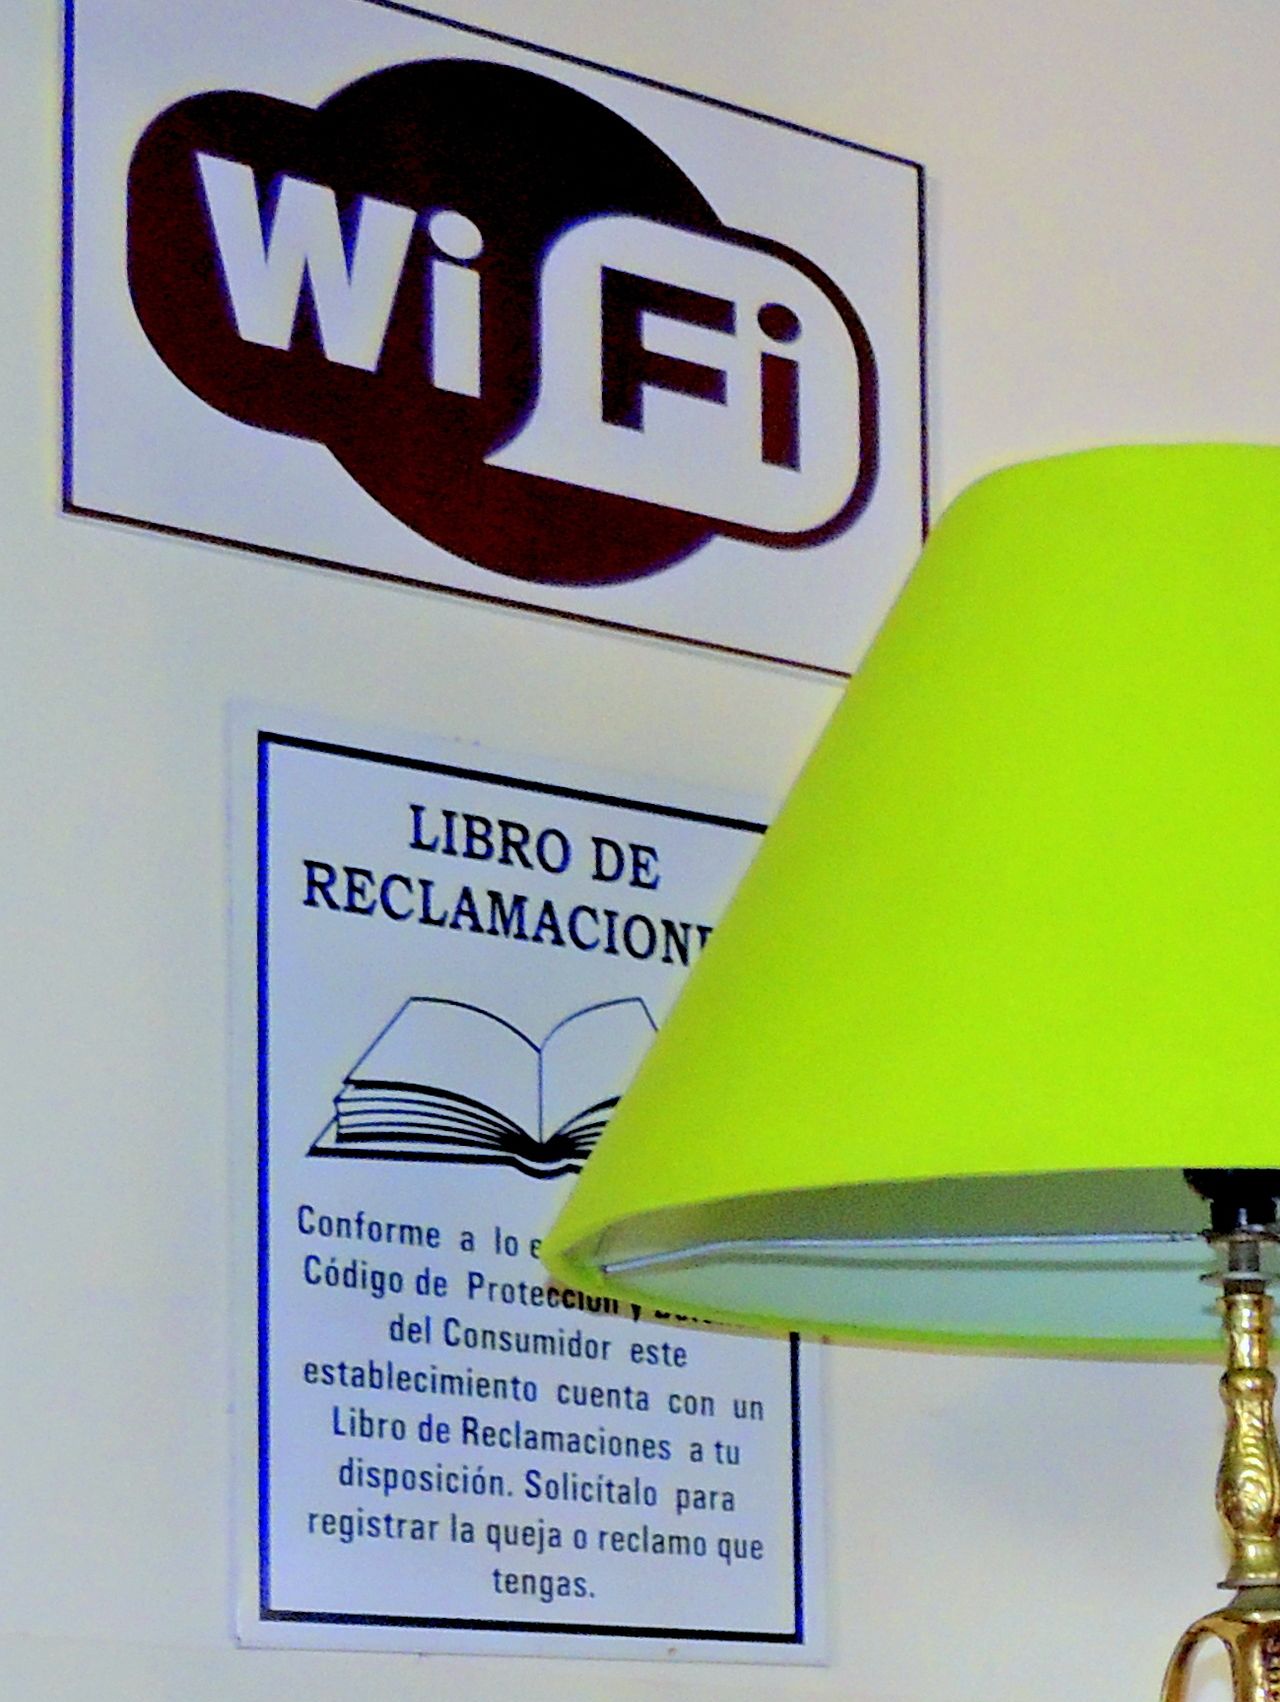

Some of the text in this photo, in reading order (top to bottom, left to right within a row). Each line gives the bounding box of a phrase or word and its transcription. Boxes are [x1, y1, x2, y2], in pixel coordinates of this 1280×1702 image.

[408, 804, 661, 890] LIBRO DE
[297, 1204, 441, 1249] Conforme
[460, 1231, 476, 1252] a
[495, 1226, 519, 1257] lo
[303, 1254, 403, 1299] Código
[415, 1266, 448, 1298] de
[389, 1313, 688, 1368] del Consumidor este
[303, 1359, 764, 1421] establecimiento cuenta con un
[332, 1405, 740, 1466] Libro de Reclamaciones a tu
[338, 1456, 513, 1498] disposición.
[676, 1487, 735, 1515] para
[308, 1507, 764, 1566] registrar la queja o reclamo que
[492, 1568, 595, 1604] tengas.
